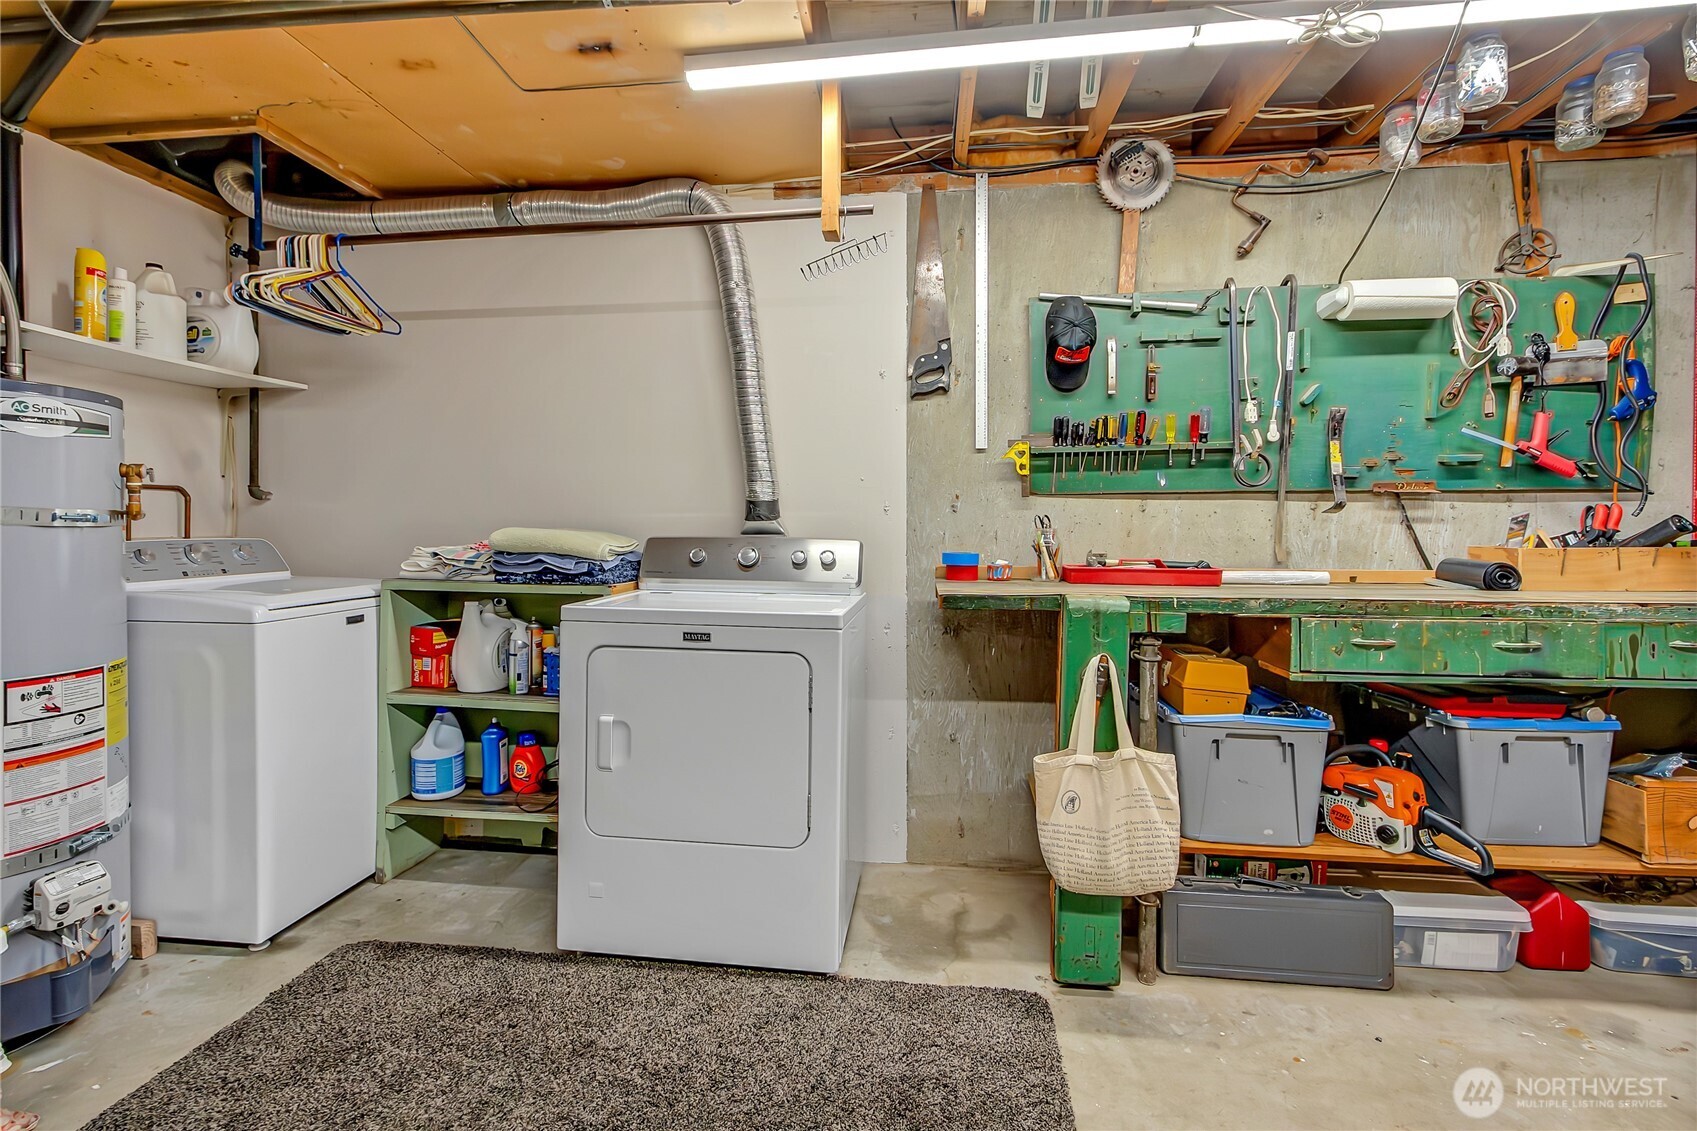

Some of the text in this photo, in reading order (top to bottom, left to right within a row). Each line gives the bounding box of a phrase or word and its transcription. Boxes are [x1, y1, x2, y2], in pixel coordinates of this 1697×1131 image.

[32, 404, 67, 416] Smith
[1396, 482, 1429, 490] Deluxe
[684, 633, 710, 641] MAYTAG
[514, 764, 526, 774] Tide
[1331, 810, 1351, 822] STIHL
